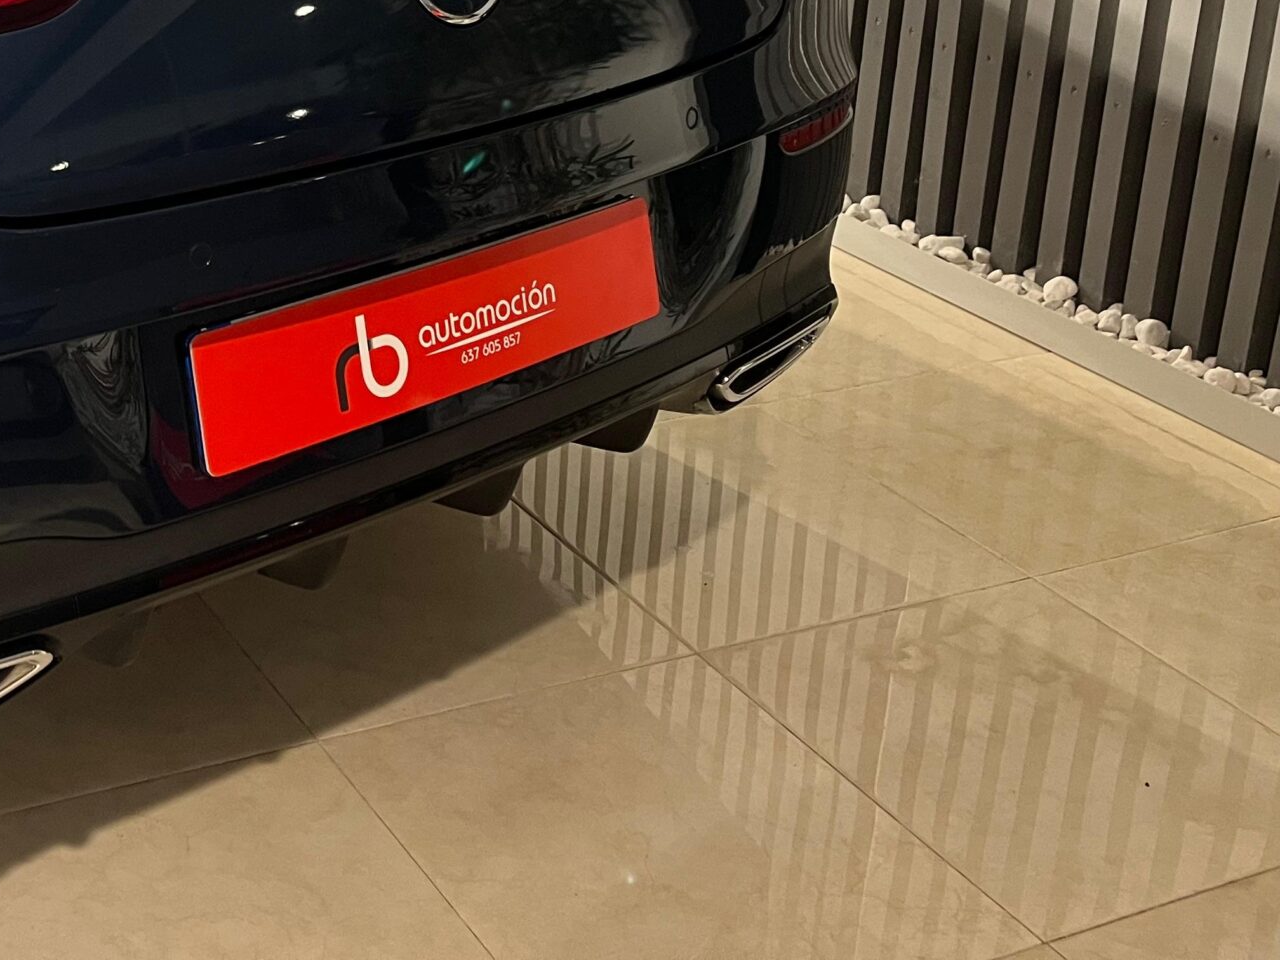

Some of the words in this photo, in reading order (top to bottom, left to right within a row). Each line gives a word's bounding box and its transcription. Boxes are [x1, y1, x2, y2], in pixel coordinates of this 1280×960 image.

[418, 280, 557, 348] automoción
[461, 346, 480, 365] 637
[482, 339, 502, 357] 605
[503, 331, 521, 349] 857
[335, 313, 409, 413] rb
